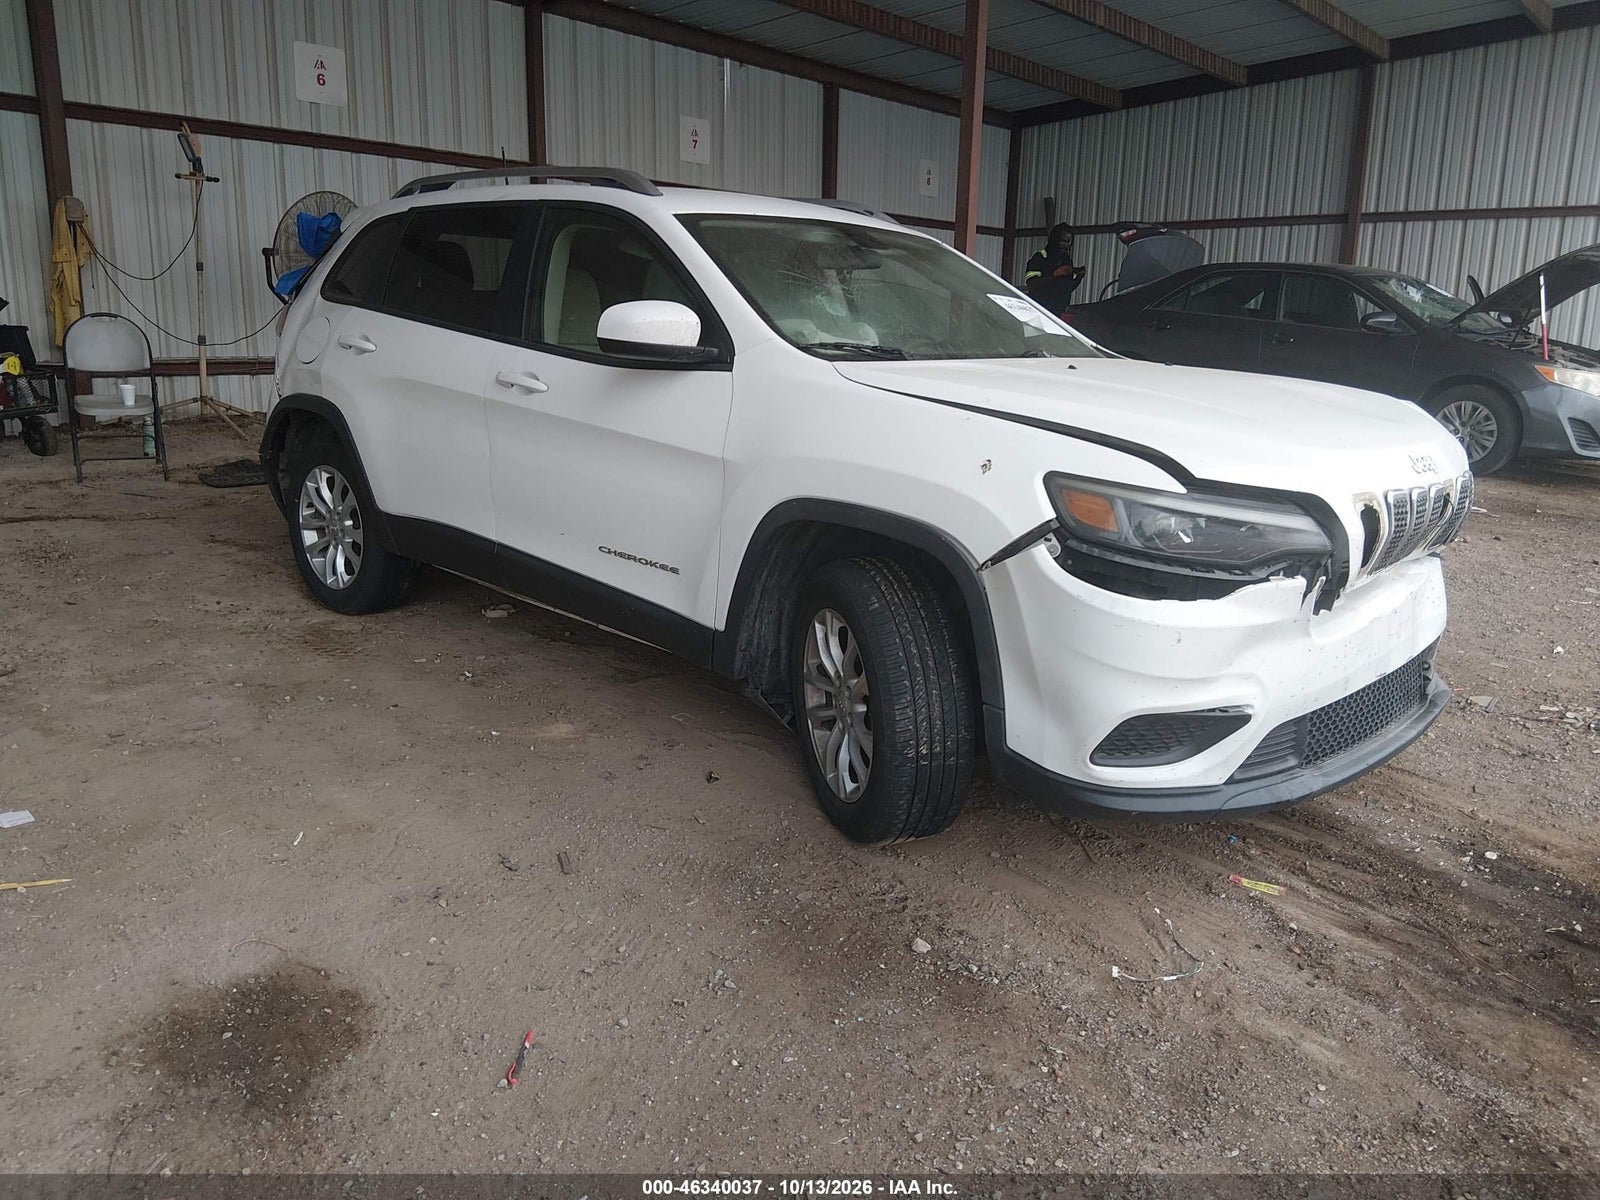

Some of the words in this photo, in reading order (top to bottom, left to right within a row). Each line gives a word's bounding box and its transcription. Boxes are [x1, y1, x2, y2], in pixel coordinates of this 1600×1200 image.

[316, 73, 326, 87] 6
[692, 139, 698, 150] 7
[598, 545, 680, 576] CHEROKEE
